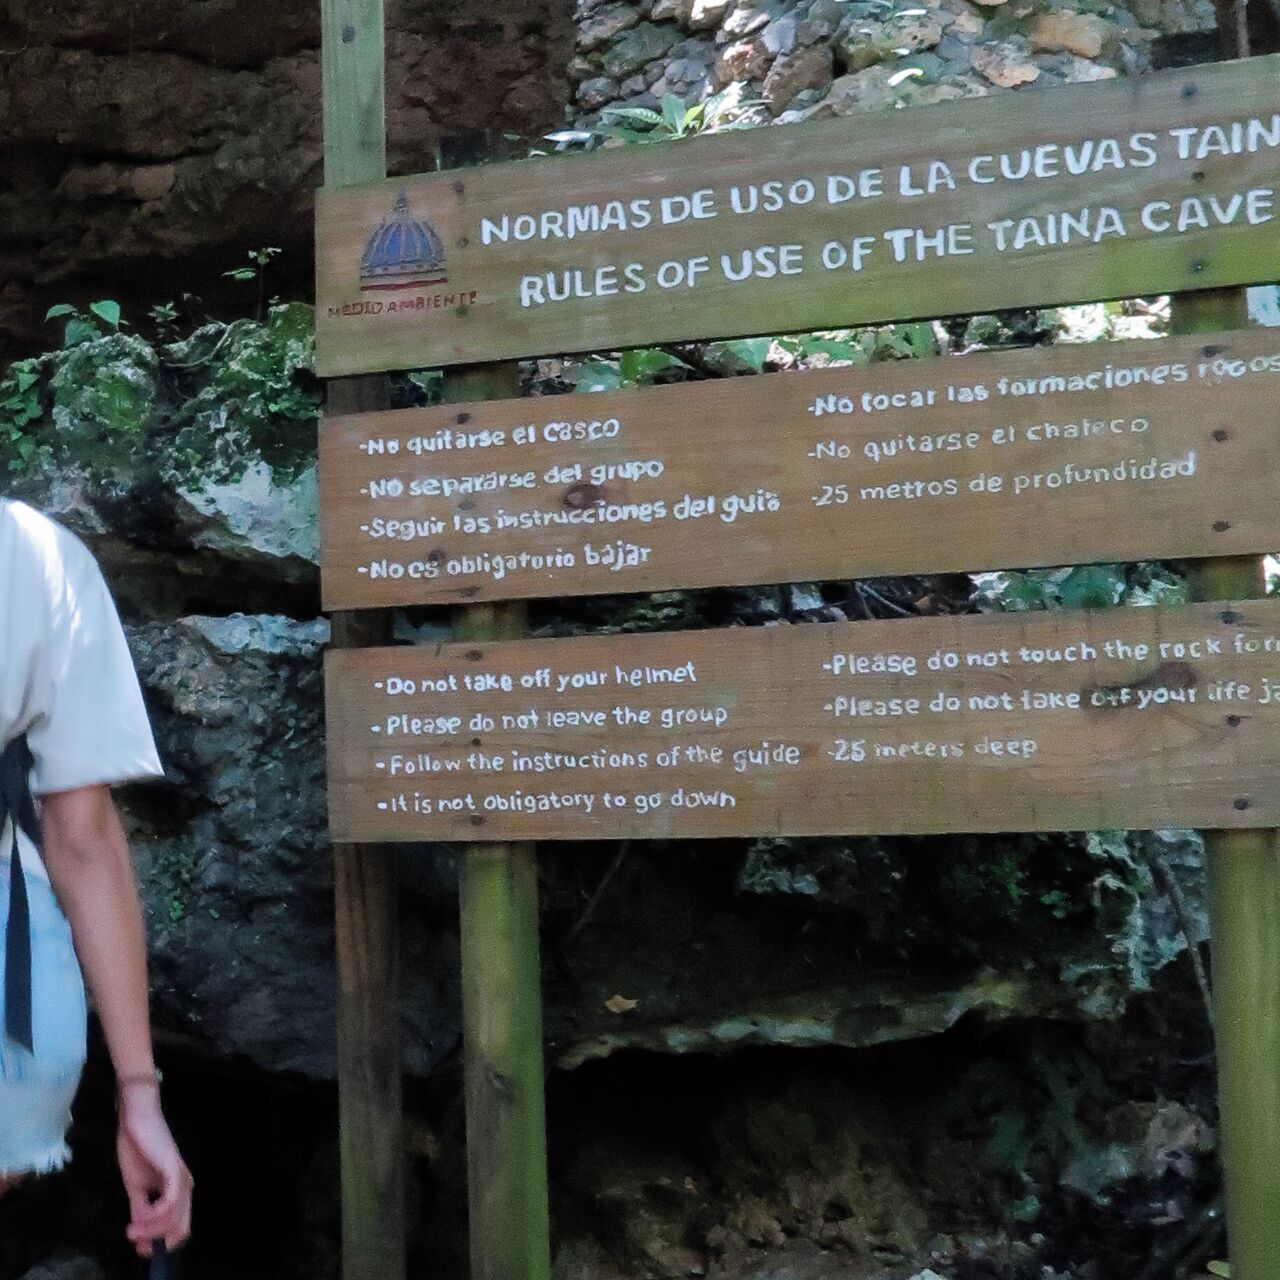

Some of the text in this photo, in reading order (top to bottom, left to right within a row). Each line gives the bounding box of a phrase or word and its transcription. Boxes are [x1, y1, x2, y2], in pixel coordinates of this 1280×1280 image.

[481, 199, 651, 245] NORMAS
[661, 189, 717, 224] DE
[731, 179, 816, 214] USO
[827, 169, 883, 204] DE
[899, 160, 956, 196] LA
[969, 132, 1157, 184] CUEVAS
[520, 189, 1276, 308] RULES OF USE OF THE TAINA CAVE
[328, 291, 477, 318] MEDIO AMBIENTE
[861, 389, 937, 413] tocar
[947, 384, 990, 403] las
[996, 363, 1189, 397] formaciones
[406, 428, 506, 455] quitarse
[512, 424, 536, 445] el
[543, 419, 619, 442] casco
[863, 432, 980, 462] quitarse
[991, 425, 1015, 444] el
[1026, 418, 1149, 441] chaleco
[408, 471, 536, 497] separarse
[543, 464, 583, 484] del
[590, 461, 664, 486] grupo
[860, 478, 958, 500] metros
[968, 472, 1003, 493] de
[1013, 451, 1196, 494] profundidad
[453, 513, 491, 534] las
[496, 499, 667, 530] instrucciones
[673, 494, 715, 520] del
[408, 561, 439, 579] es
[447, 548, 575, 580] obligatorio
[583, 540, 652, 571] bajar
[927, 650, 959, 670] do
[967, 648, 1009, 667] not
[1019, 642, 1097, 663] touch
[1103, 639, 1149, 660] the
[1159, 635, 1221, 659] rock
[421, 674, 458, 692] not
[464, 672, 512, 692] take
[520, 668, 551, 688] off
[555, 670, 608, 692] your
[615, 661, 697, 686] helmet
[929, 692, 961, 712] do
[968, 691, 1014, 711] not
[1021, 688, 1081, 710] take
[1136, 687, 1197, 709] your
[469, 713, 495, 732] do
[502, 709, 539, 730] not
[547, 708, 606, 727] leave
[612, 706, 651, 726] the
[661, 707, 727, 728] group
[467, 751, 505, 771] the
[511, 749, 648, 772] instructions
[656, 745, 680, 767] of
[685, 744, 722, 763] the
[733, 742, 800, 773] guide
[875, 740, 964, 758] meters
[974, 737, 1038, 759] deep
[414, 791, 432, 814] is
[438, 793, 475, 812] not
[484, 790, 594, 813] obligatory
[603, 792, 626, 808] to
[634, 792, 661, 813] go
[670, 789, 736, 808] down
